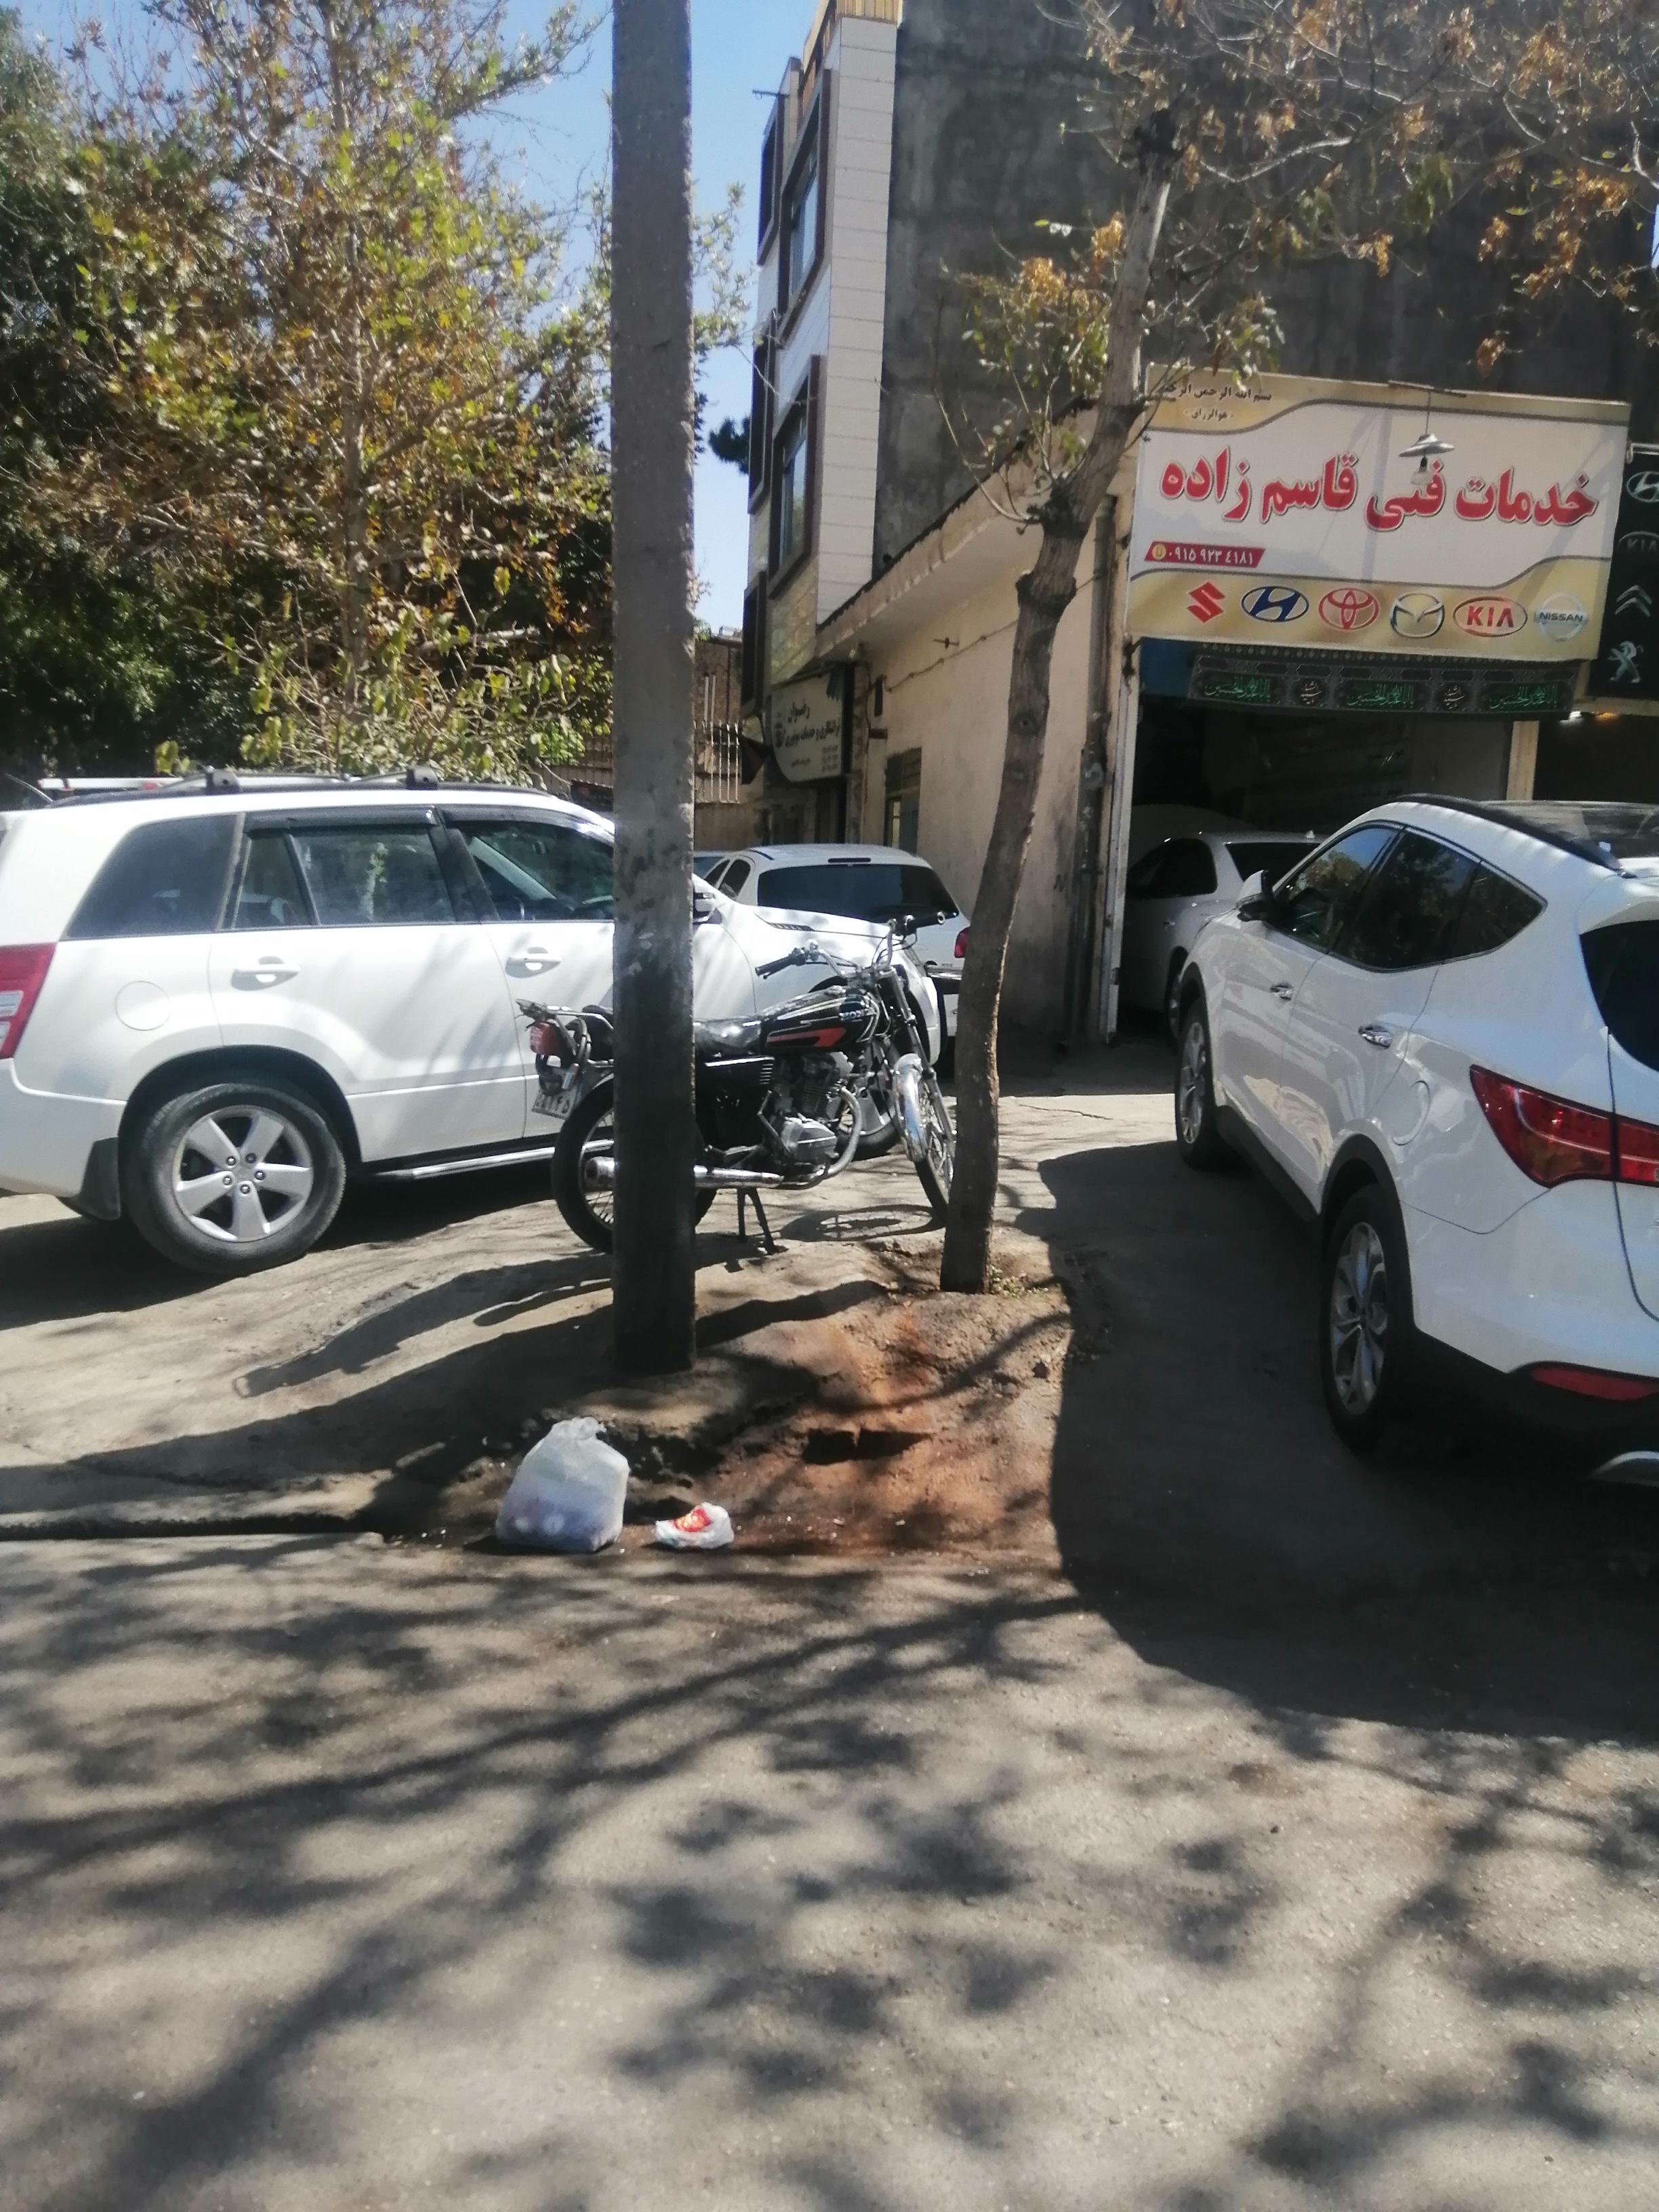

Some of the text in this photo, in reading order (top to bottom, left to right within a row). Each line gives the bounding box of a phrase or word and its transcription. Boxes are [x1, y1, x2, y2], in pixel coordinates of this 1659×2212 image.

[1159, 445, 1599, 533] خدمات فنی قاسم زاده
[1466, 605, 1515, 628] KIA
[1538, 611, 1584, 622] NISSAN
